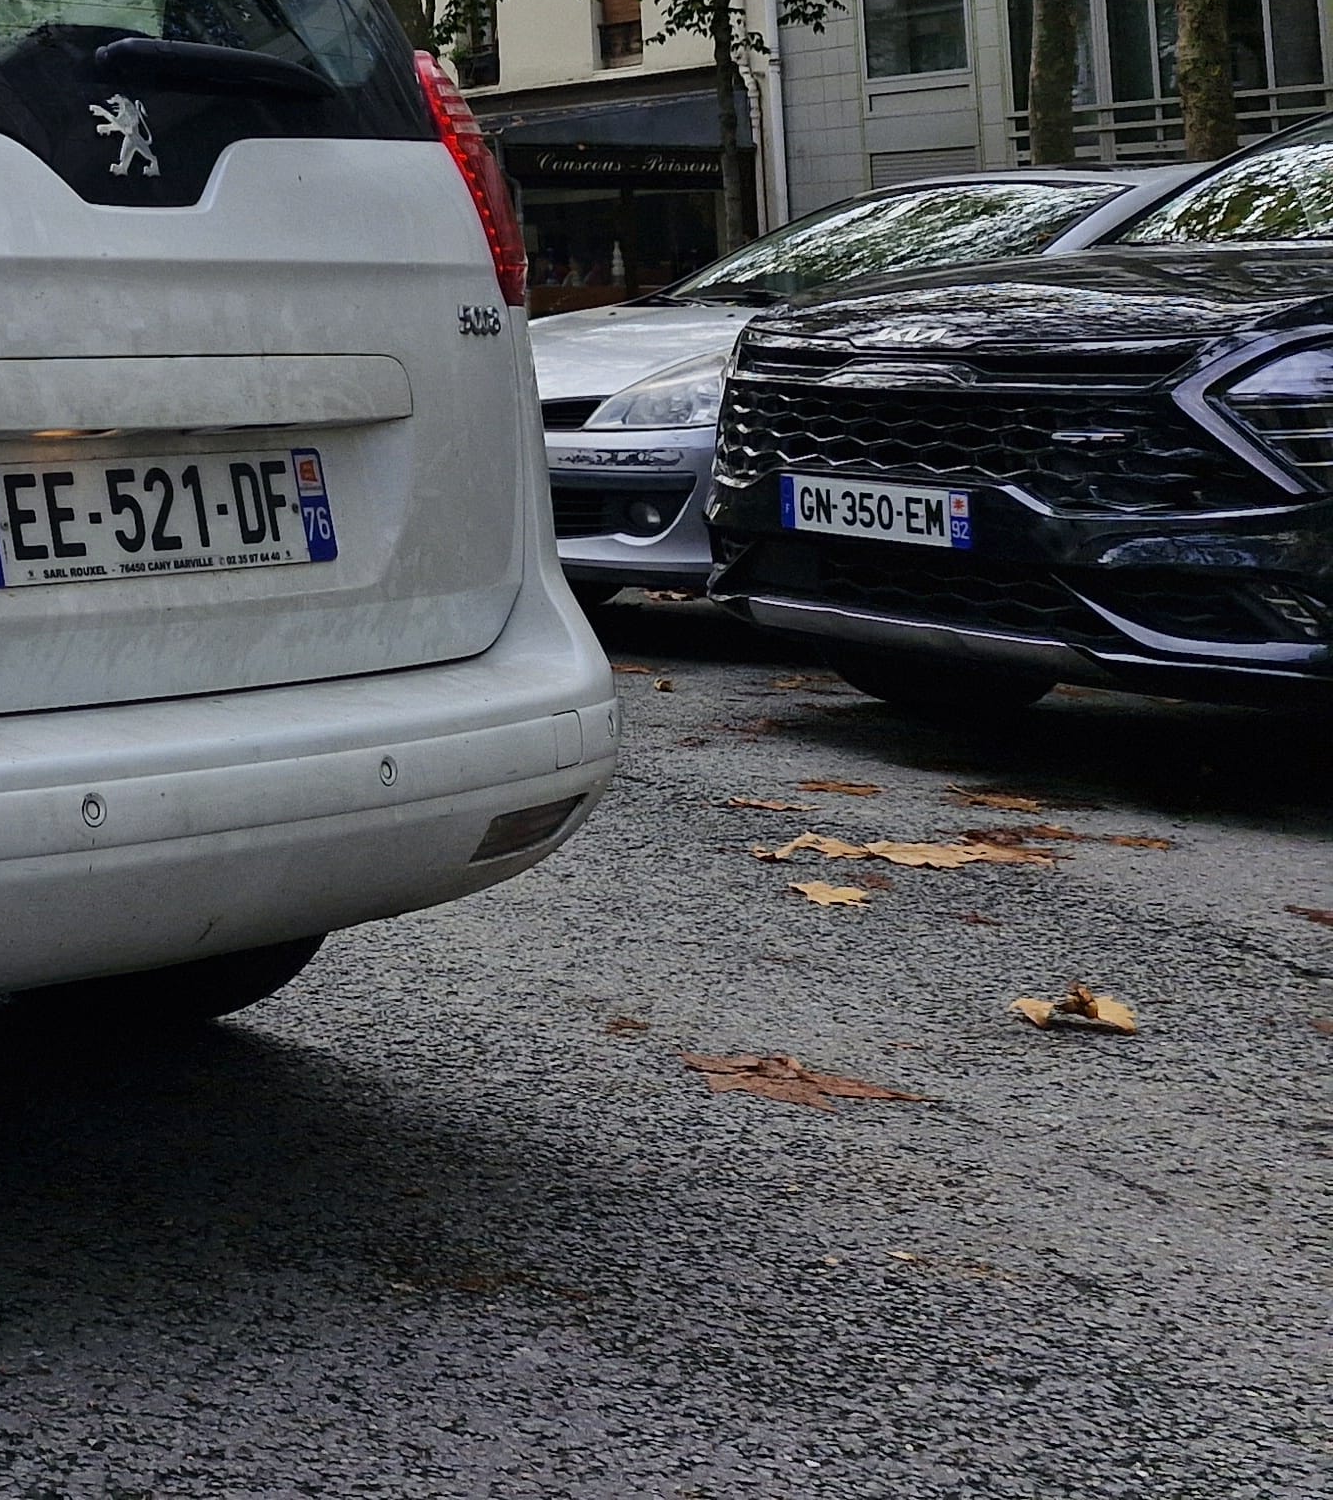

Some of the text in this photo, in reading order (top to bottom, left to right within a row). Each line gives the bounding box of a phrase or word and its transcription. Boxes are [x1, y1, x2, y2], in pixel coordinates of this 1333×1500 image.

[536, 151, 622, 172] Couscous
[3, 460, 287, 561] EE-521-DF
[302, 506, 331, 541] 76
[800, 486, 945, 537] GN-350-EM
[951, 520, 971, 540] 92
[43, 567, 68, 579] SARL
[70, 565, 108, 578] ROUXEL
[147, 561, 171, 572] CANY
[173, 557, 214, 570] BARVILLE
